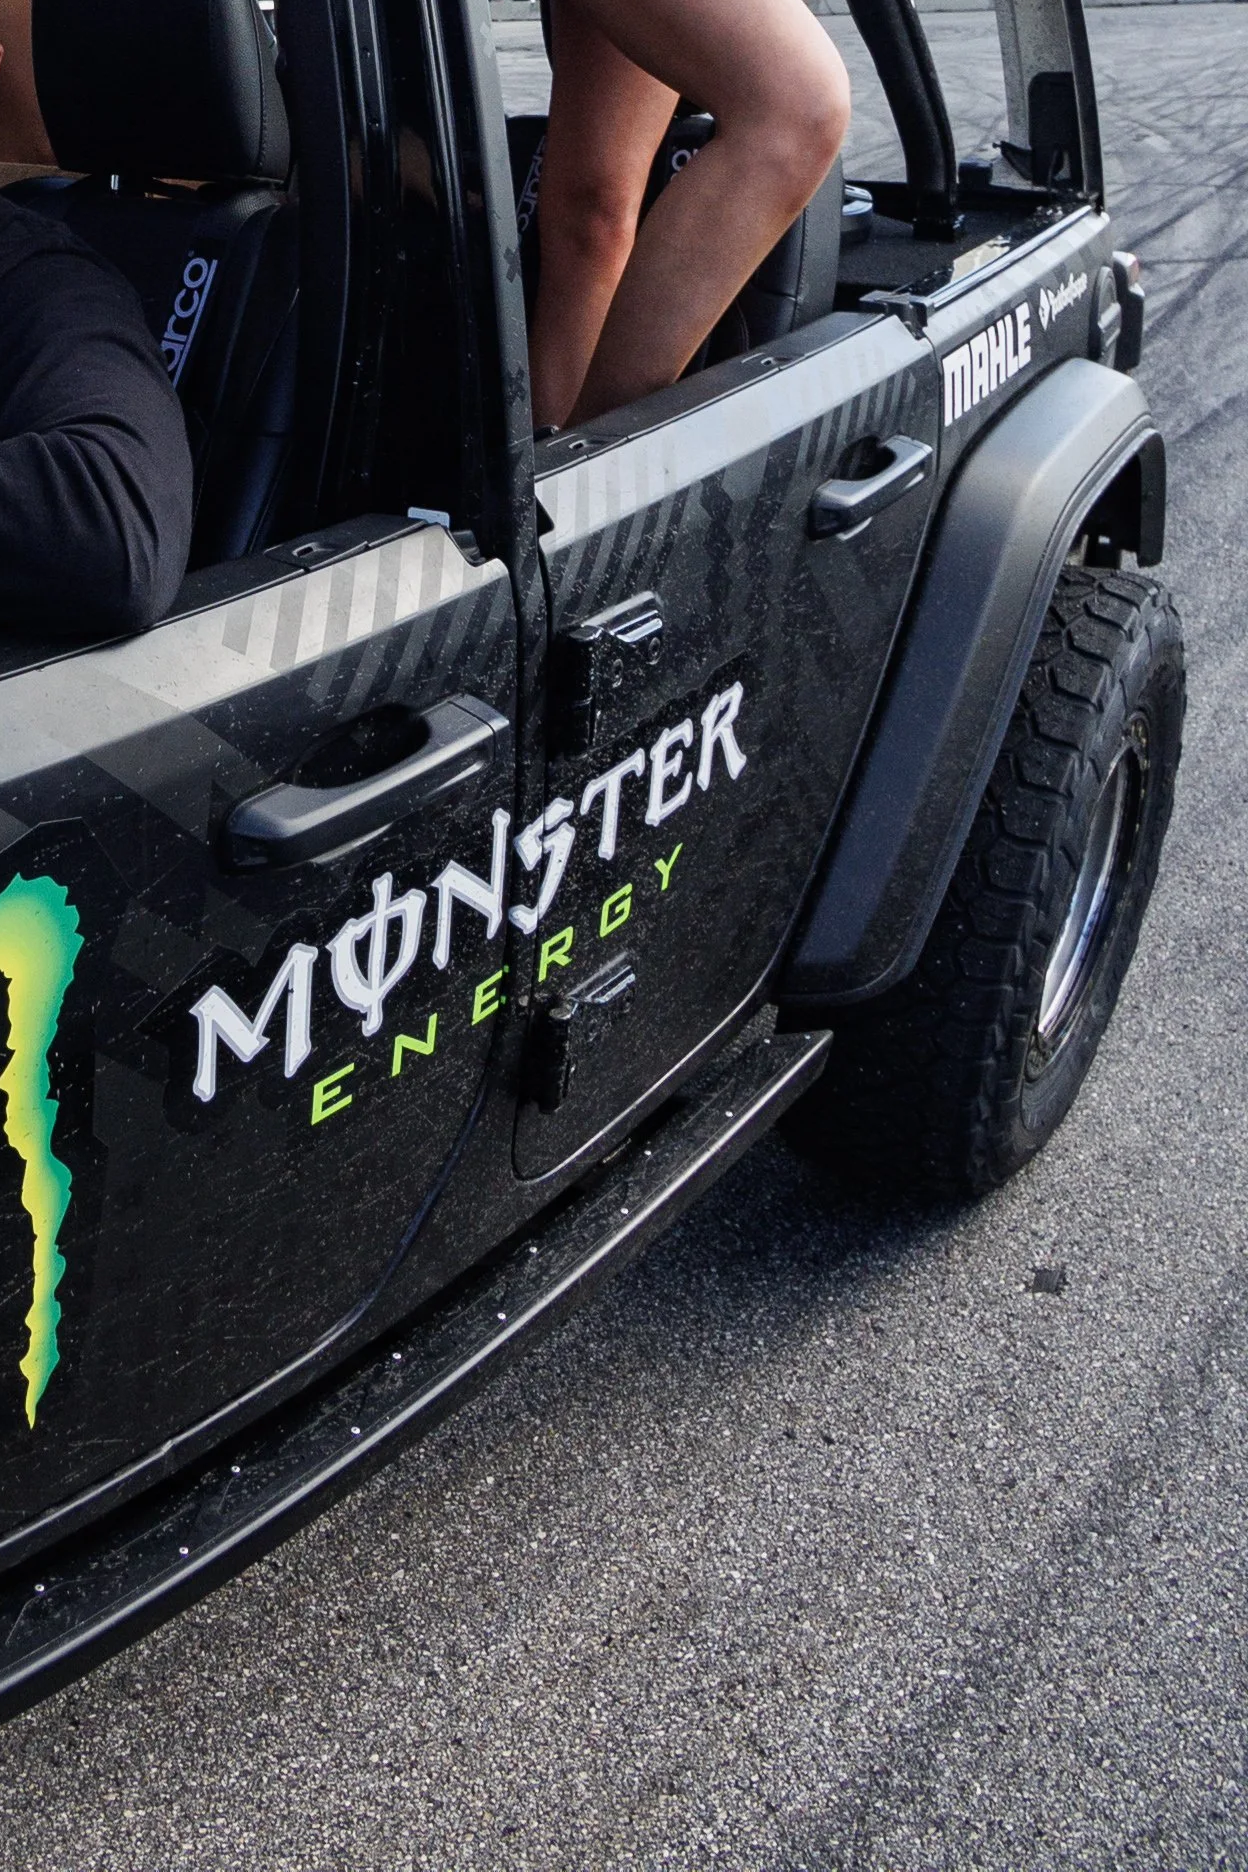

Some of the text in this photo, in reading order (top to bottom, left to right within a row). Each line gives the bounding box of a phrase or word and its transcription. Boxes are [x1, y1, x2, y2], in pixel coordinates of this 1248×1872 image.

[941, 301, 1032, 428] MAHLE
[188, 681, 748, 1103] MONSTER
[310, 842, 684, 1127] ENERGY
